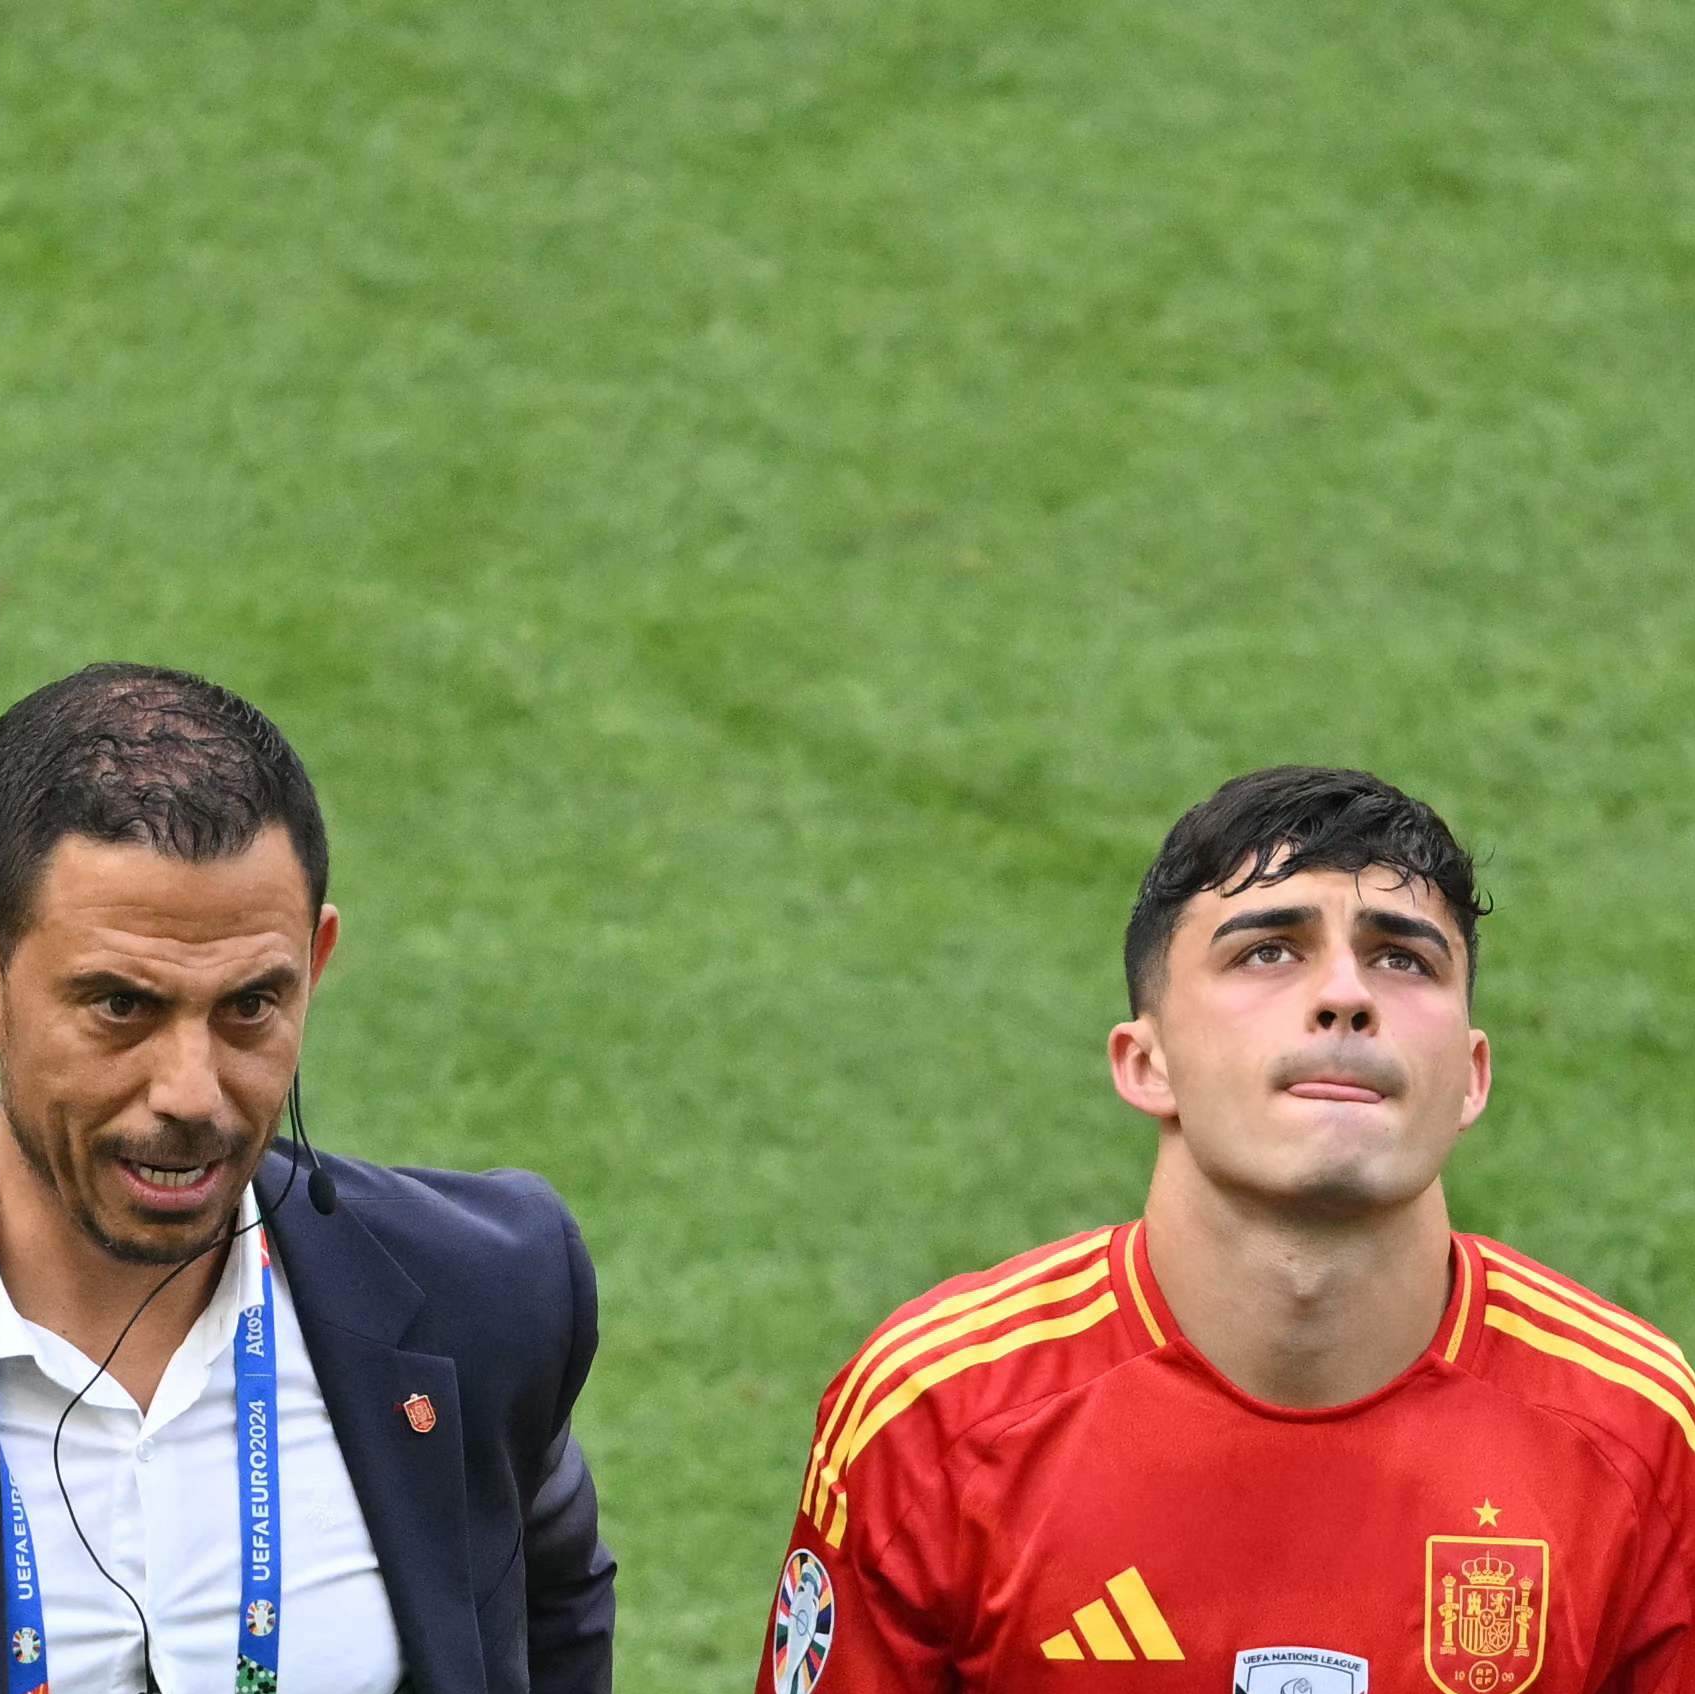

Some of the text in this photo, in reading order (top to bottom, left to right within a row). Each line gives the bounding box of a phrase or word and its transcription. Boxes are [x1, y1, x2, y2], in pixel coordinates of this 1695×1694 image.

[1243, 1652, 1362, 1672] UEFA NATIONS LEAGUE
